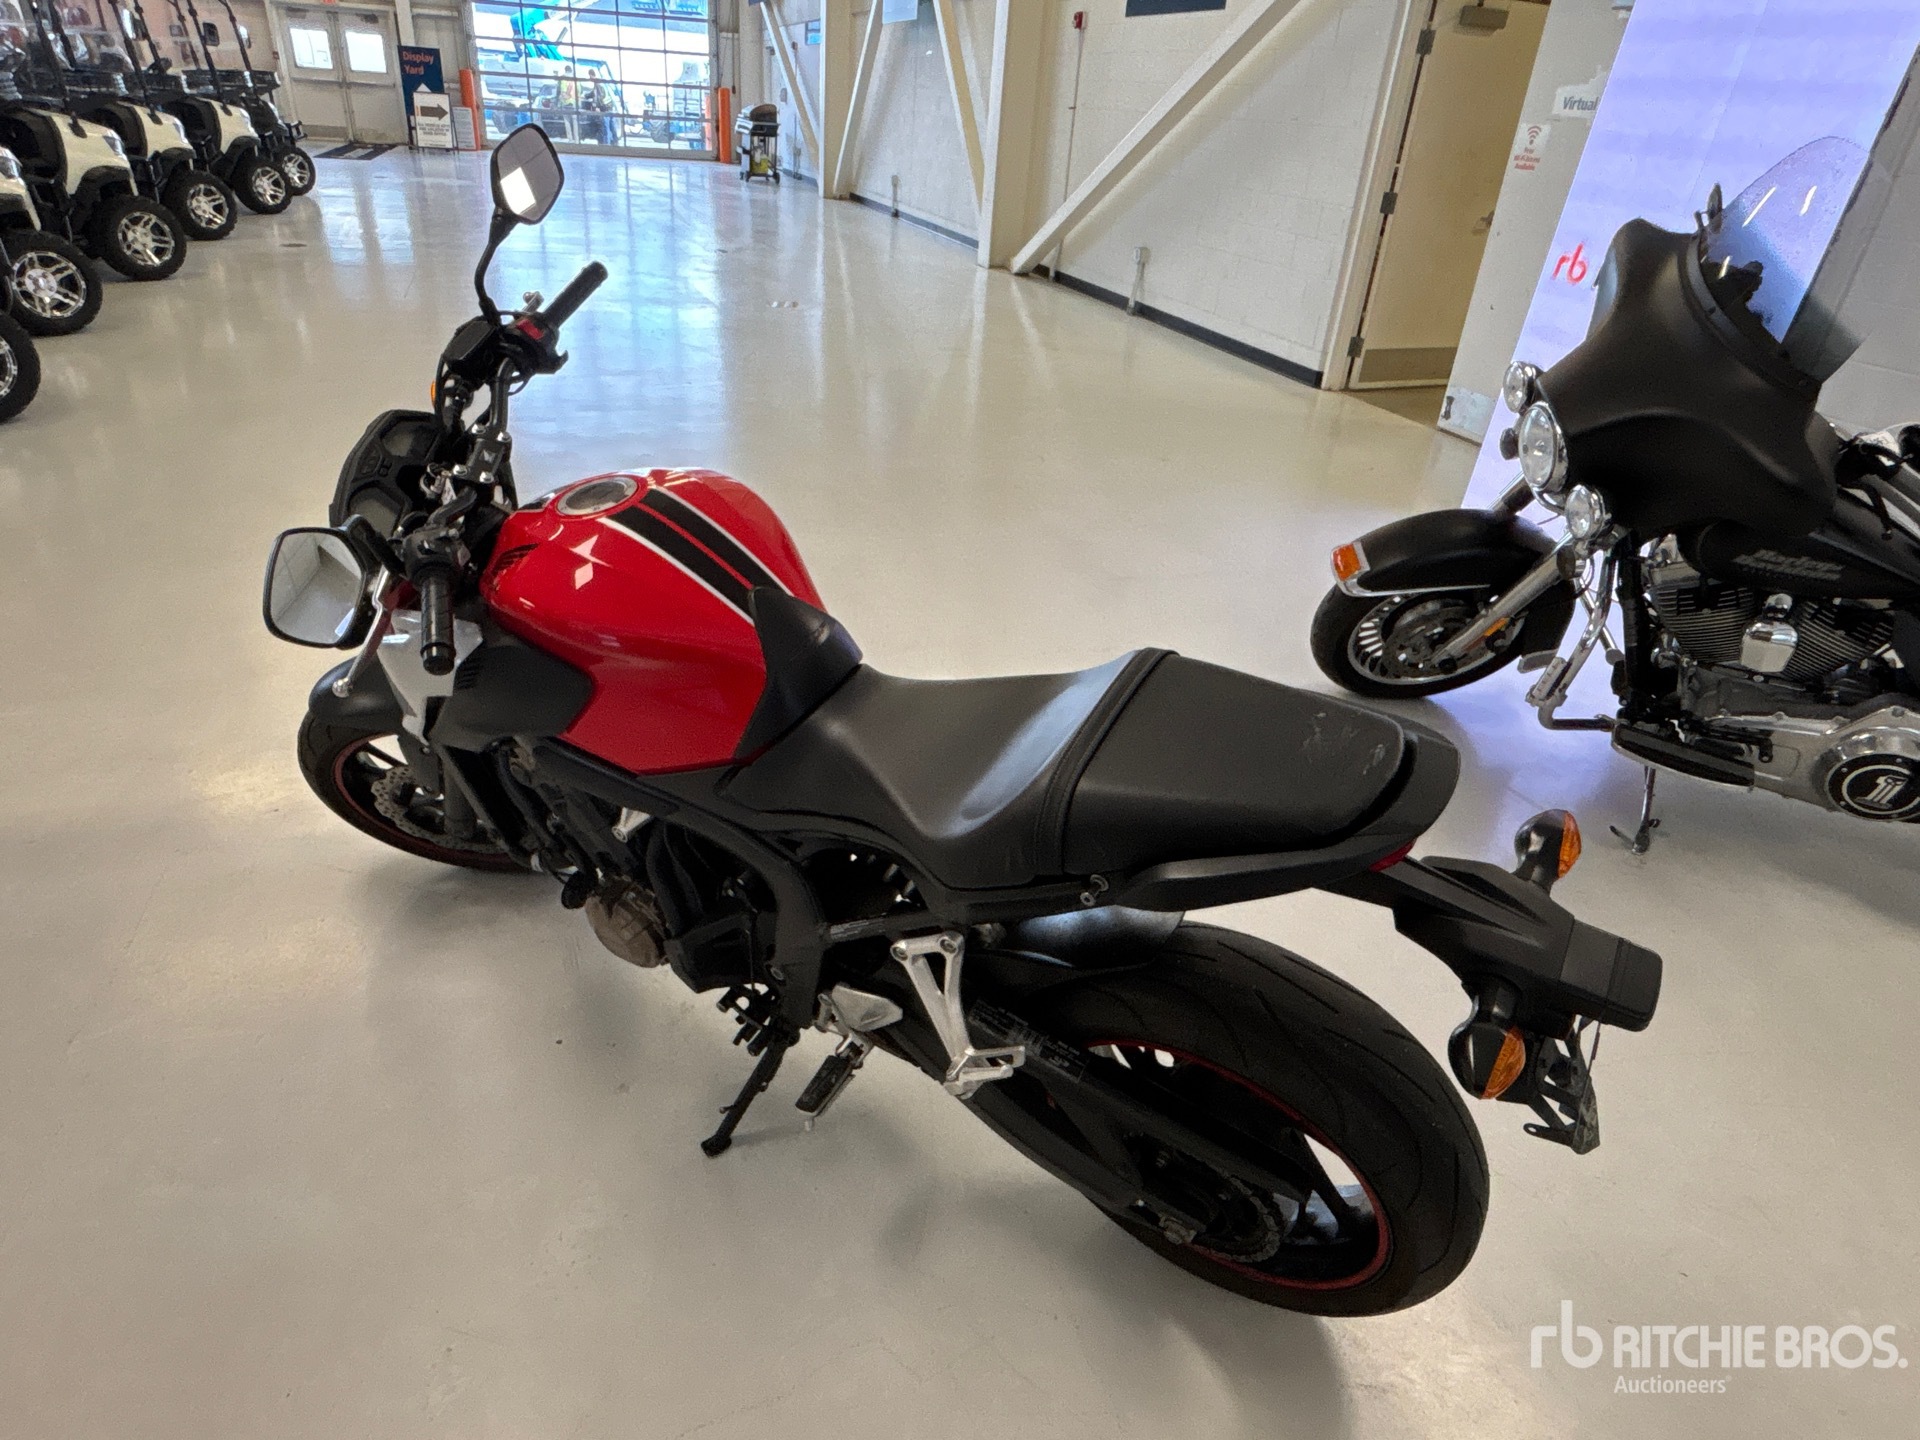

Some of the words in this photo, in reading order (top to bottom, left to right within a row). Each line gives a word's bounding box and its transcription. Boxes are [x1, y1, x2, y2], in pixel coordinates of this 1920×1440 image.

[402, 51, 434, 65] Display
[404, 65, 424, 75] Yard
[1563, 96, 1599, 111] Virtual
[1552, 243, 1587, 285] rb
